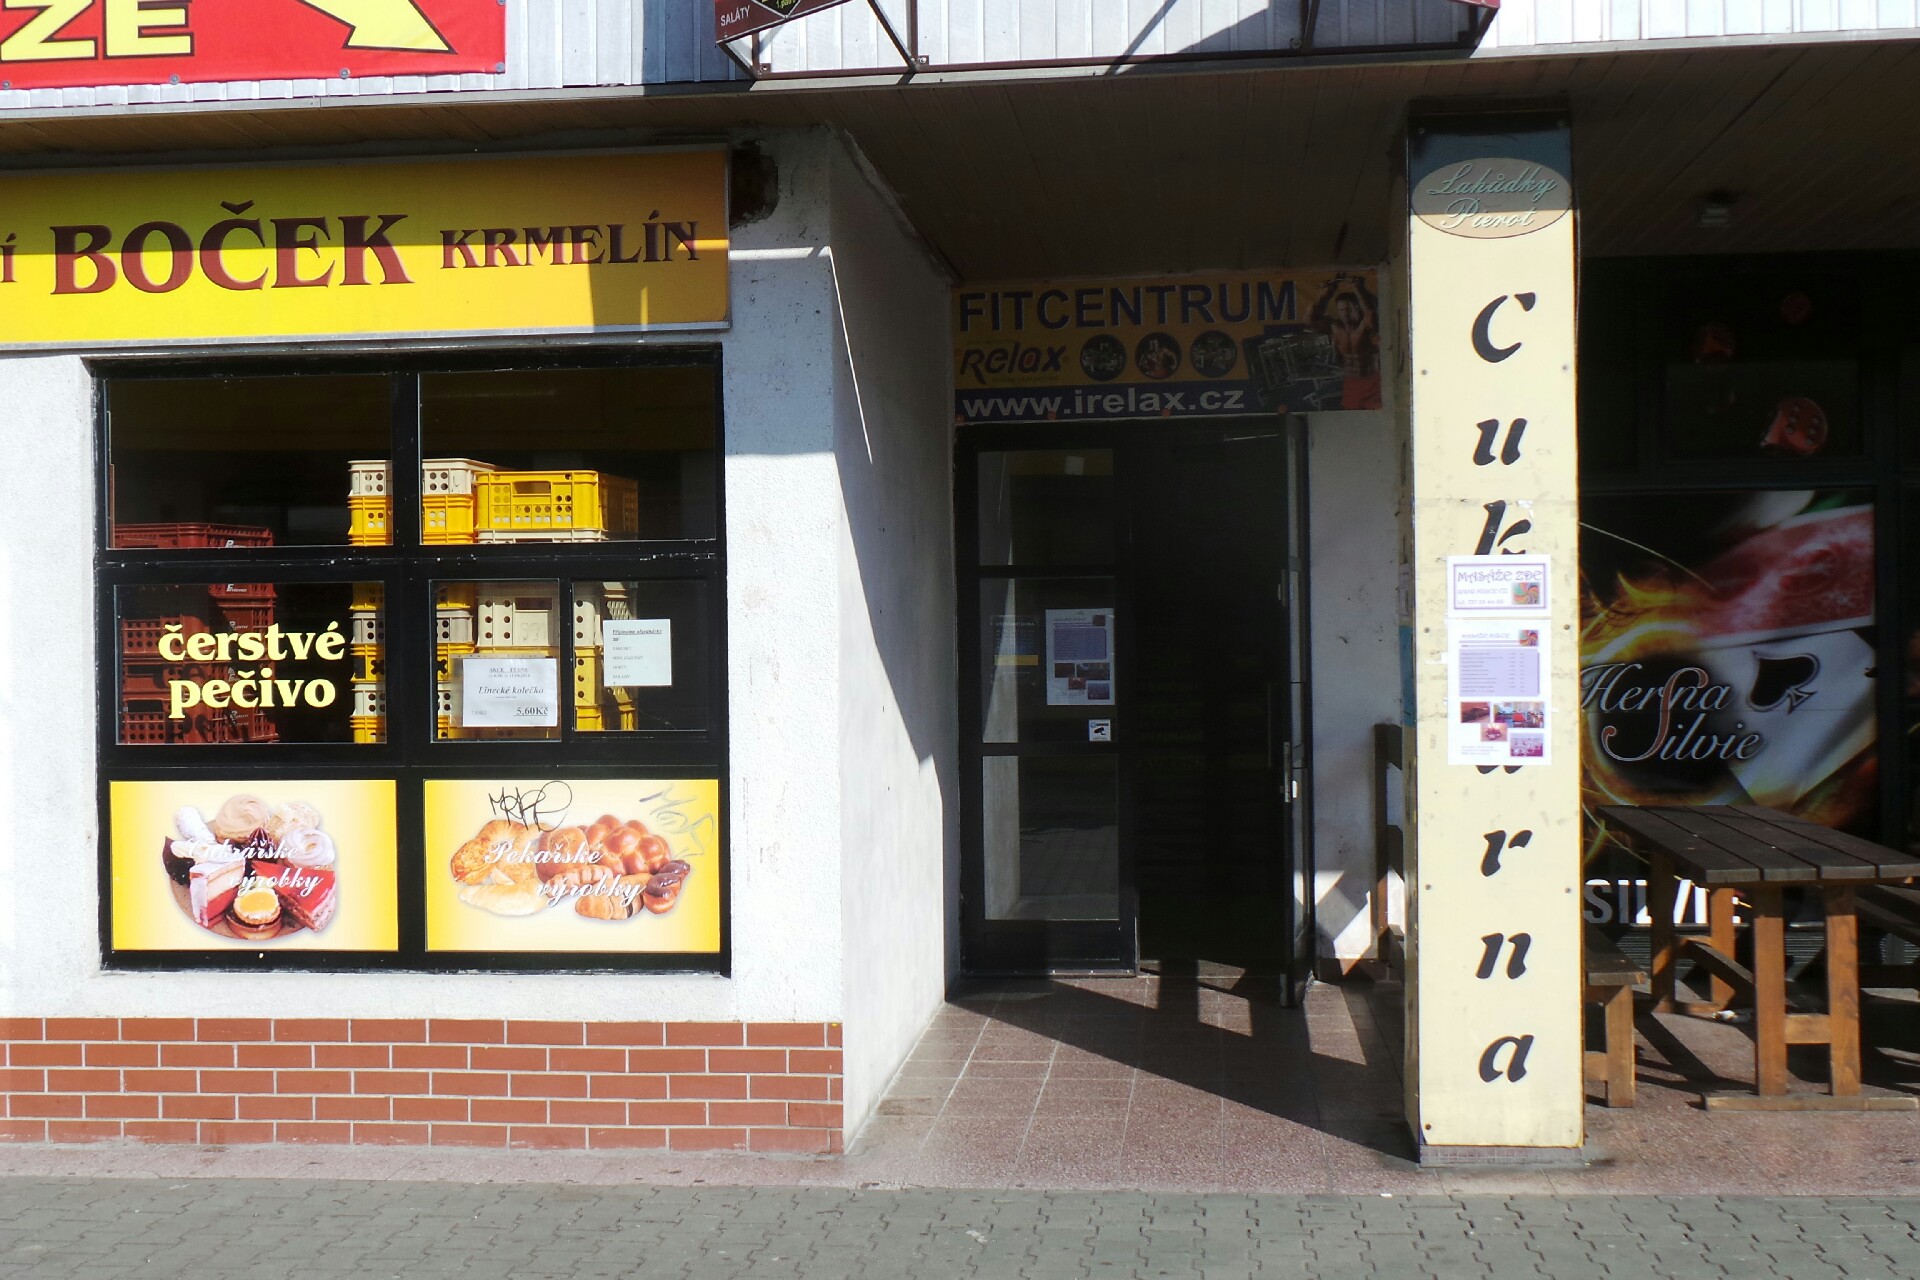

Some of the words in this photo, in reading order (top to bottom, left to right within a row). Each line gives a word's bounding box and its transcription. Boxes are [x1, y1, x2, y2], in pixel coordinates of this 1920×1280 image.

[720, 5, 750, 27] SALÁTY
[1427, 163, 1558, 203] Lahůdky
[1440, 197, 1538, 230] Pierot
[49, 200, 416, 296] BOČEK
[440, 209, 700, 270] KRMELÍN
[959, 280, 1297, 332] FITCENTRUM
[959, 341, 1067, 386] Relax
[962, 386, 1245, 418] www.irelax.cz
[1456, 568, 1513, 584] MASÁŽE
[1515, 569, 1543, 582] ZDE
[158, 620, 346, 662] čerstvé
[168, 667, 337, 719] pečivo
[478, 686, 511, 695] Linecké
[512, 686, 544, 695] kolečko
[1471, 291, 1537, 1084] Cukrna
[1579, 662, 1731, 712] Herna
[516, 706, 549, 716] 5,60Kč
[1600, 667, 1768, 762] Silvie
[484, 838, 606, 864] Pekařské
[228, 867, 324, 897] výrobky
[536, 874, 648, 907] výrobky
